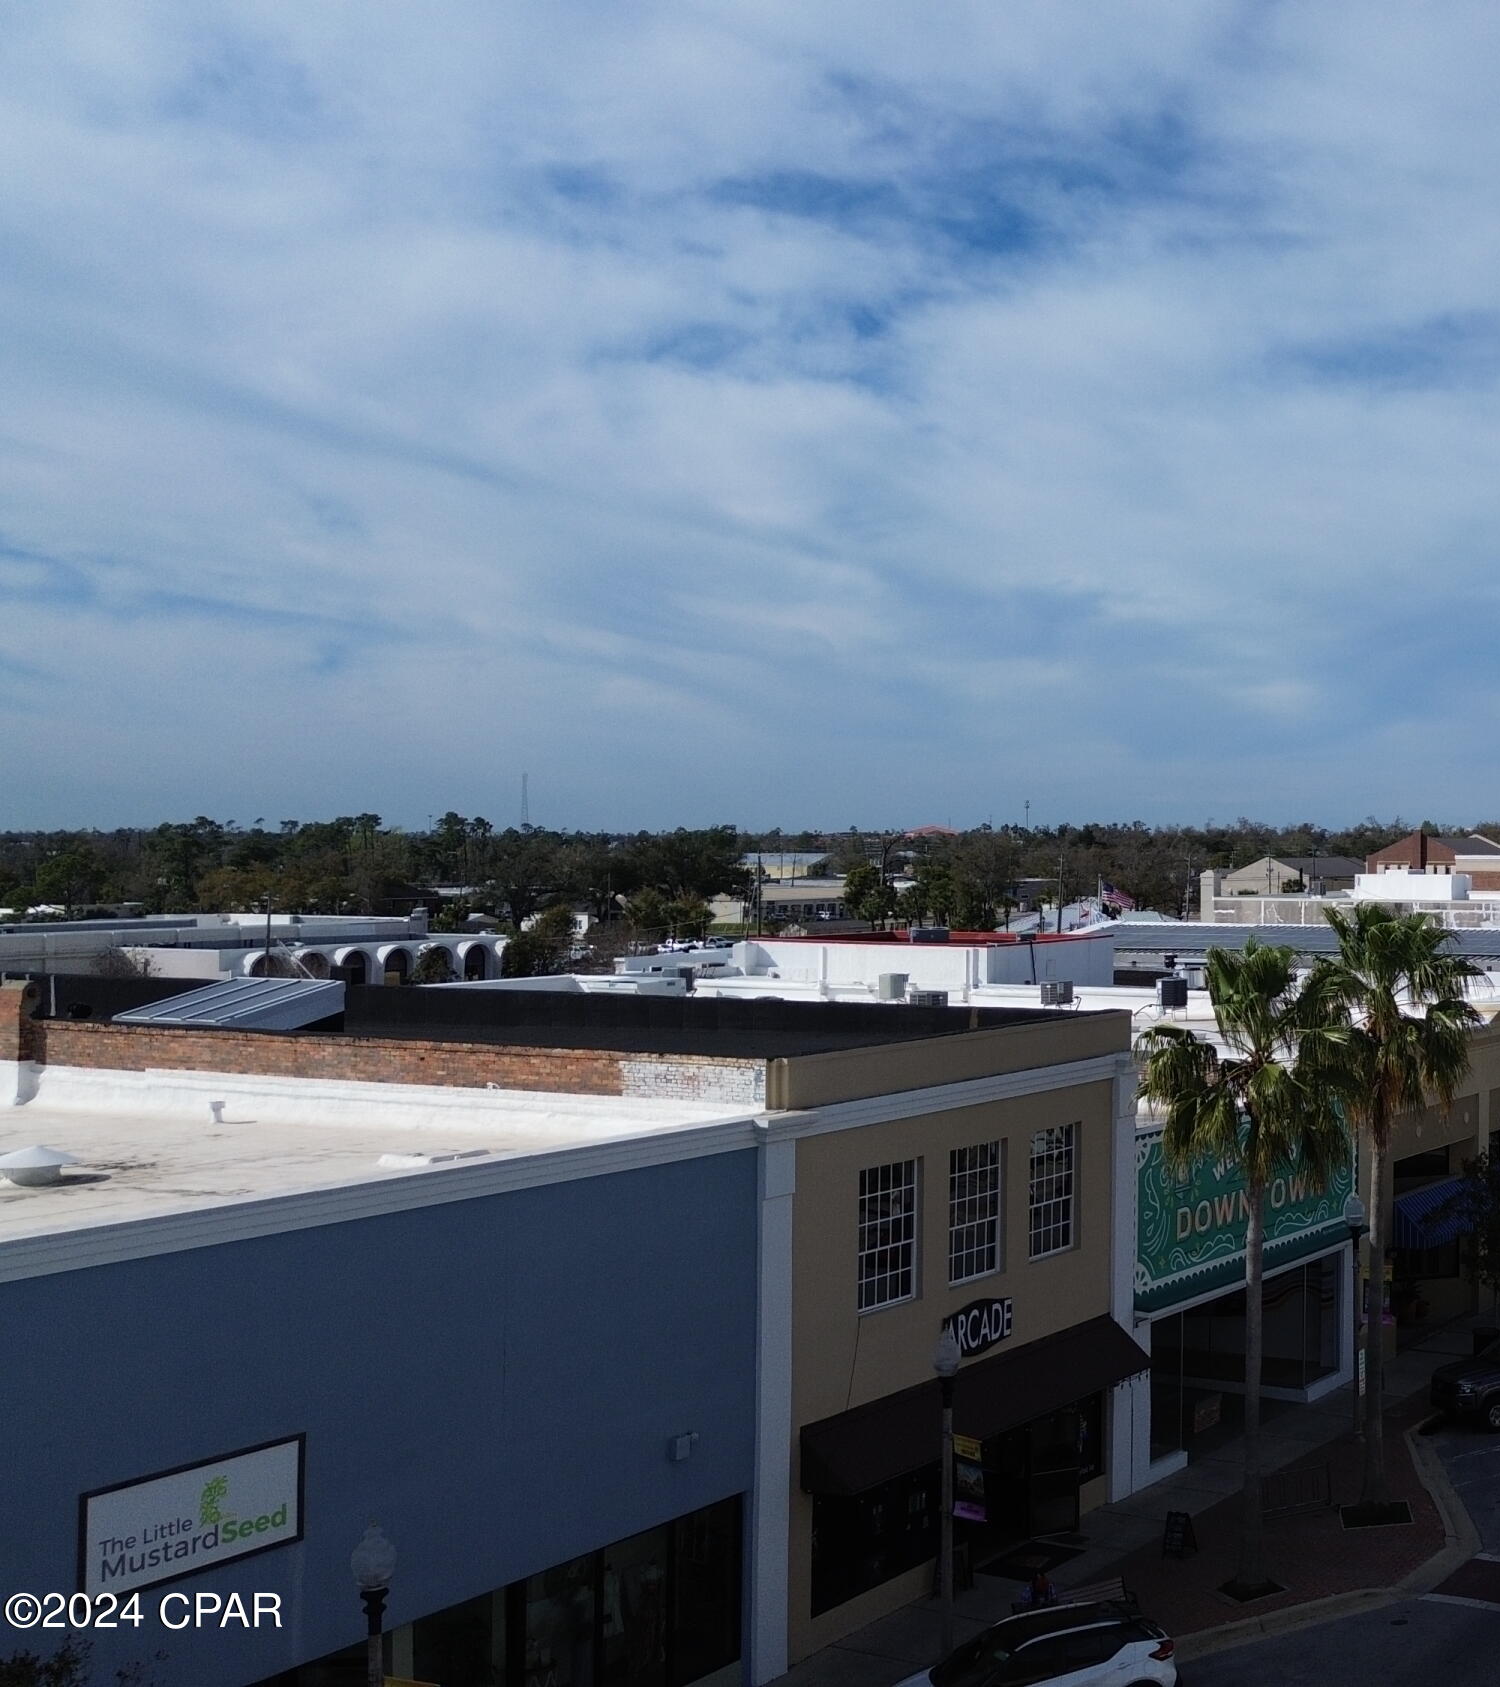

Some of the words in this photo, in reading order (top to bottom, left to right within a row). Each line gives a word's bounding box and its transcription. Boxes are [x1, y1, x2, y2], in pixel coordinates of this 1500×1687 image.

[1176, 1167, 1323, 1242] DOWNOW
[948, 1299, 1012, 1350] ARCADE
[99, 1536, 137, 1557] The
[143, 1518, 193, 1544] Little
